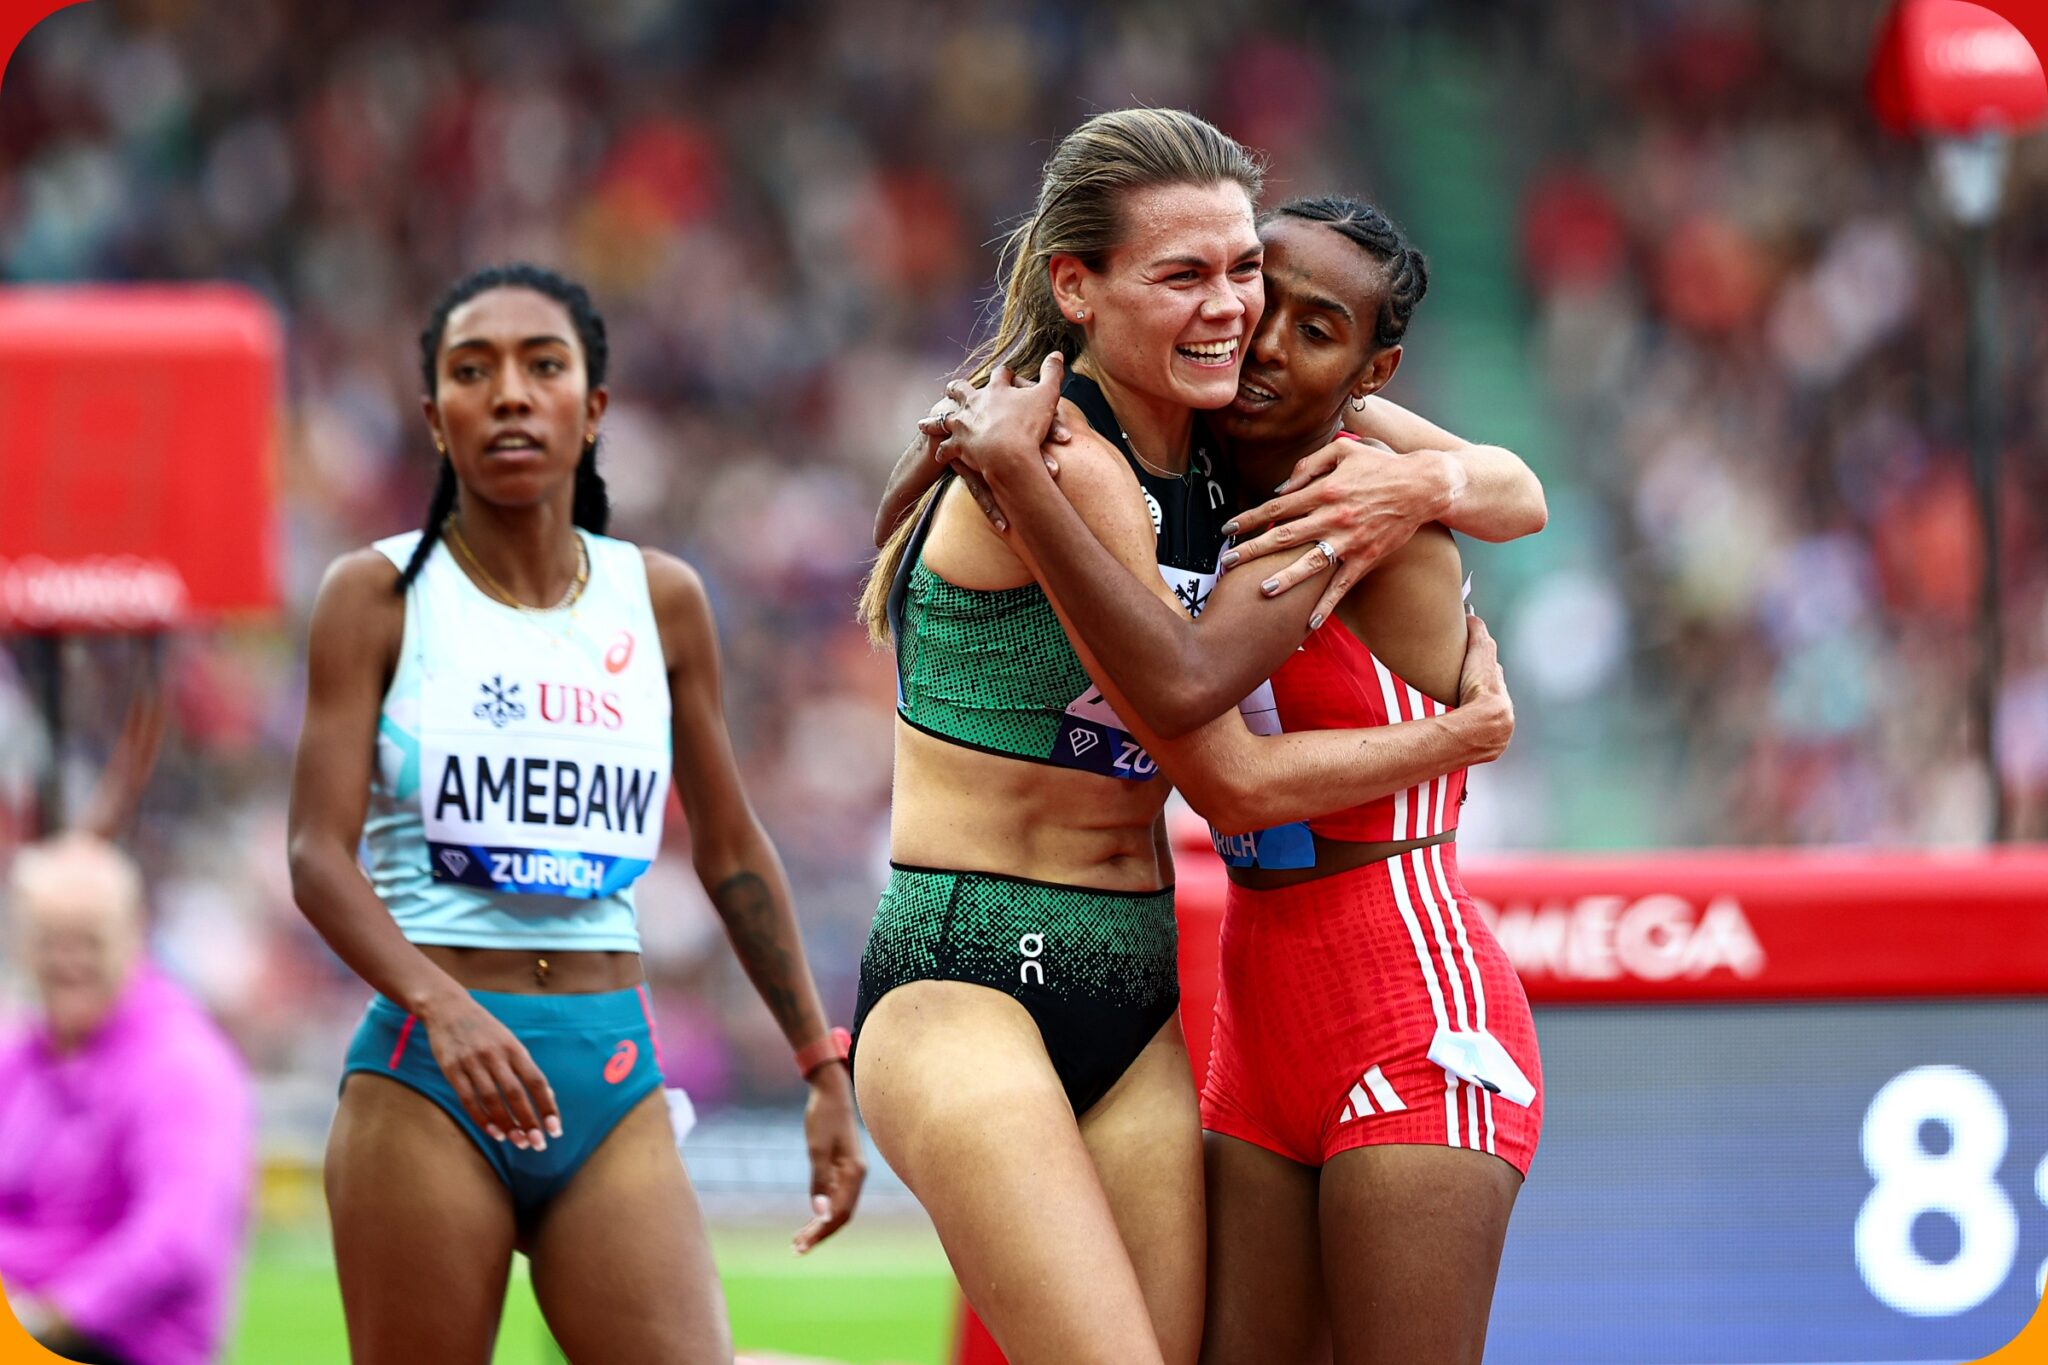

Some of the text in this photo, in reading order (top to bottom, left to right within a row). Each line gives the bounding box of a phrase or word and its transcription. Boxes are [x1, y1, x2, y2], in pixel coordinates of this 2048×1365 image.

[537, 682, 623, 731] UBS
[1112, 740, 1160, 775] ZU
[434, 755, 657, 834] AMEBAW
[489, 853, 605, 890] ZURICH
[1473, 893, 1768, 981] MEGA
